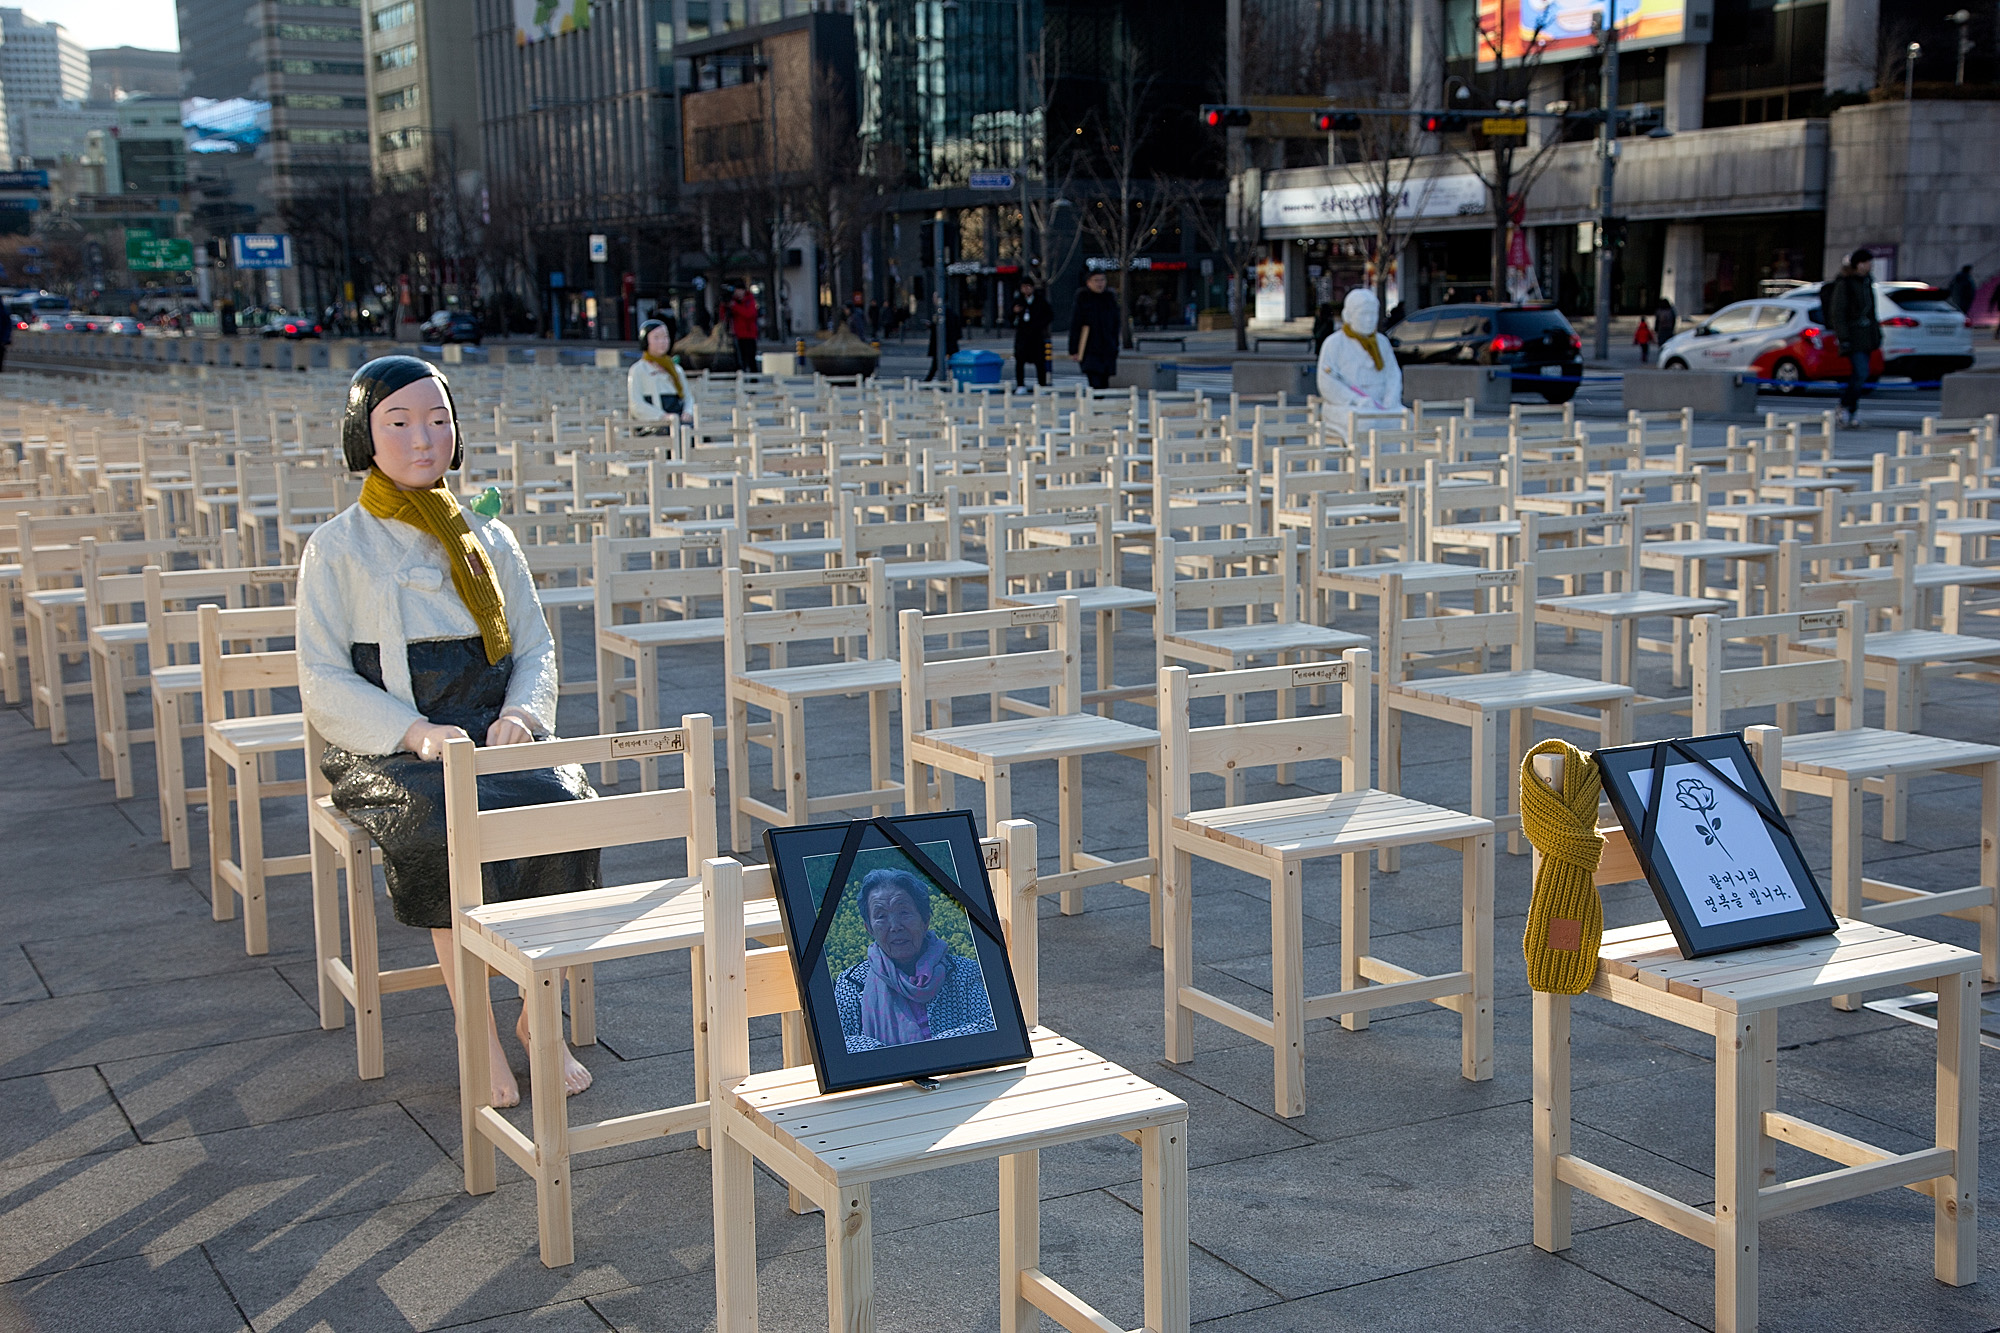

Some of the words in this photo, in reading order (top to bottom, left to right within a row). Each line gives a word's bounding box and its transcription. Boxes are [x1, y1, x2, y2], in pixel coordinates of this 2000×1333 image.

[1709, 868, 1760, 890] 할머니의
[1704, 892, 1743, 913] 명복을
[1748, 885, 1791, 906] 빕니다.
